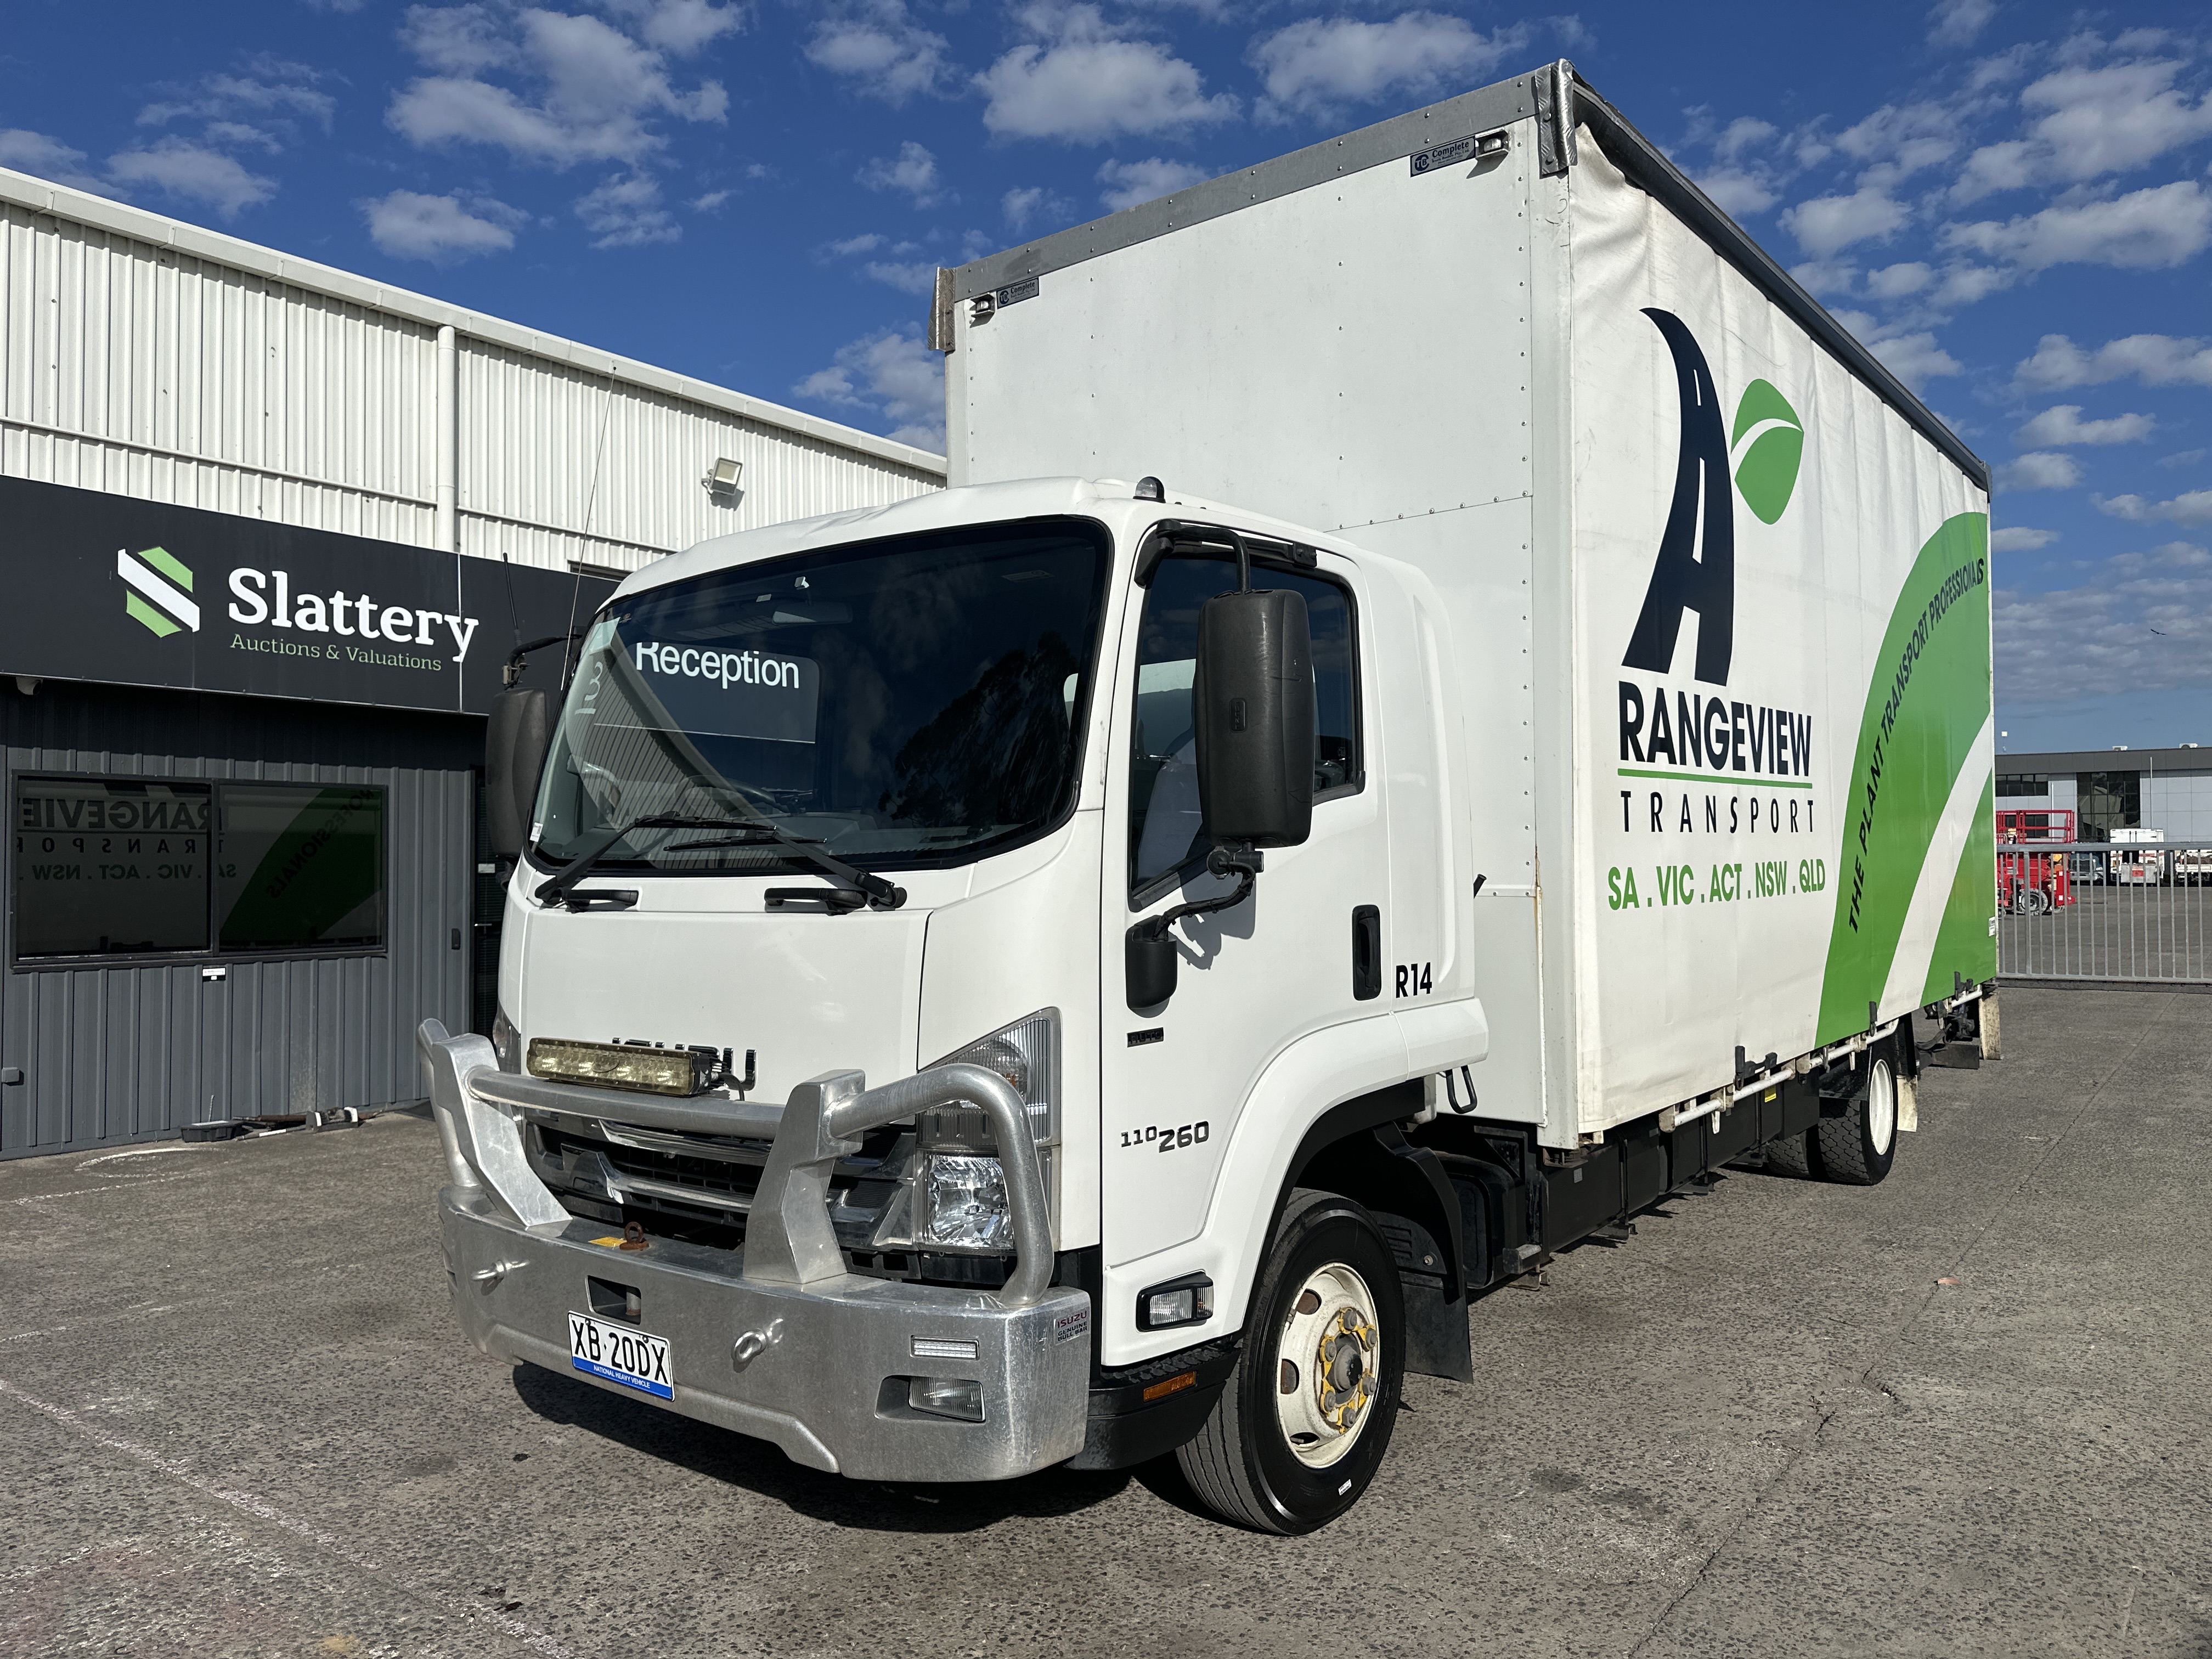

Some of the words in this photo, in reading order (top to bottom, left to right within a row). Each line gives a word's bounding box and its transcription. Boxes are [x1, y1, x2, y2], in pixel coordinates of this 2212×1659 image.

[1432, 141, 1469, 158] Complete
[1011, 281, 1035, 294] Complete
[228, 567, 479, 663] Slattery
[230, 634, 320, 659] Auctions
[326, 645, 340, 660] &
[346, 647, 442, 672] Valuations
[636, 642, 799, 690] Reception
[1618, 680, 1812, 777] RANGEVIEW
[1849, 854, 1864, 934] THE
[1859, 735, 1883, 856] PLANT
[1881, 610, 1928, 746] TRANSPORT
[1620, 791, 1813, 834] TRANSPORT
[1608, 866, 1639, 911] SA
[1656, 865, 1694, 906] VIC
[1709, 863, 1742, 902] ACT
[1755, 861, 1787, 898] NSW
[1799, 858, 1826, 893] QLD
[1396, 962, 1432, 998] R14
[1057, 1310, 1087, 1329] ISUZU
[1058, 1321, 1087, 1336] GENUINE
[1058, 1331, 1074, 1342] BULL
[1075, 1325, 1087, 1335] BAR
[593, 1364, 615, 1378] NATIONAL
[615, 1372, 631, 1382] HEAVY
[631, 1376, 651, 1389] VEHICLE
